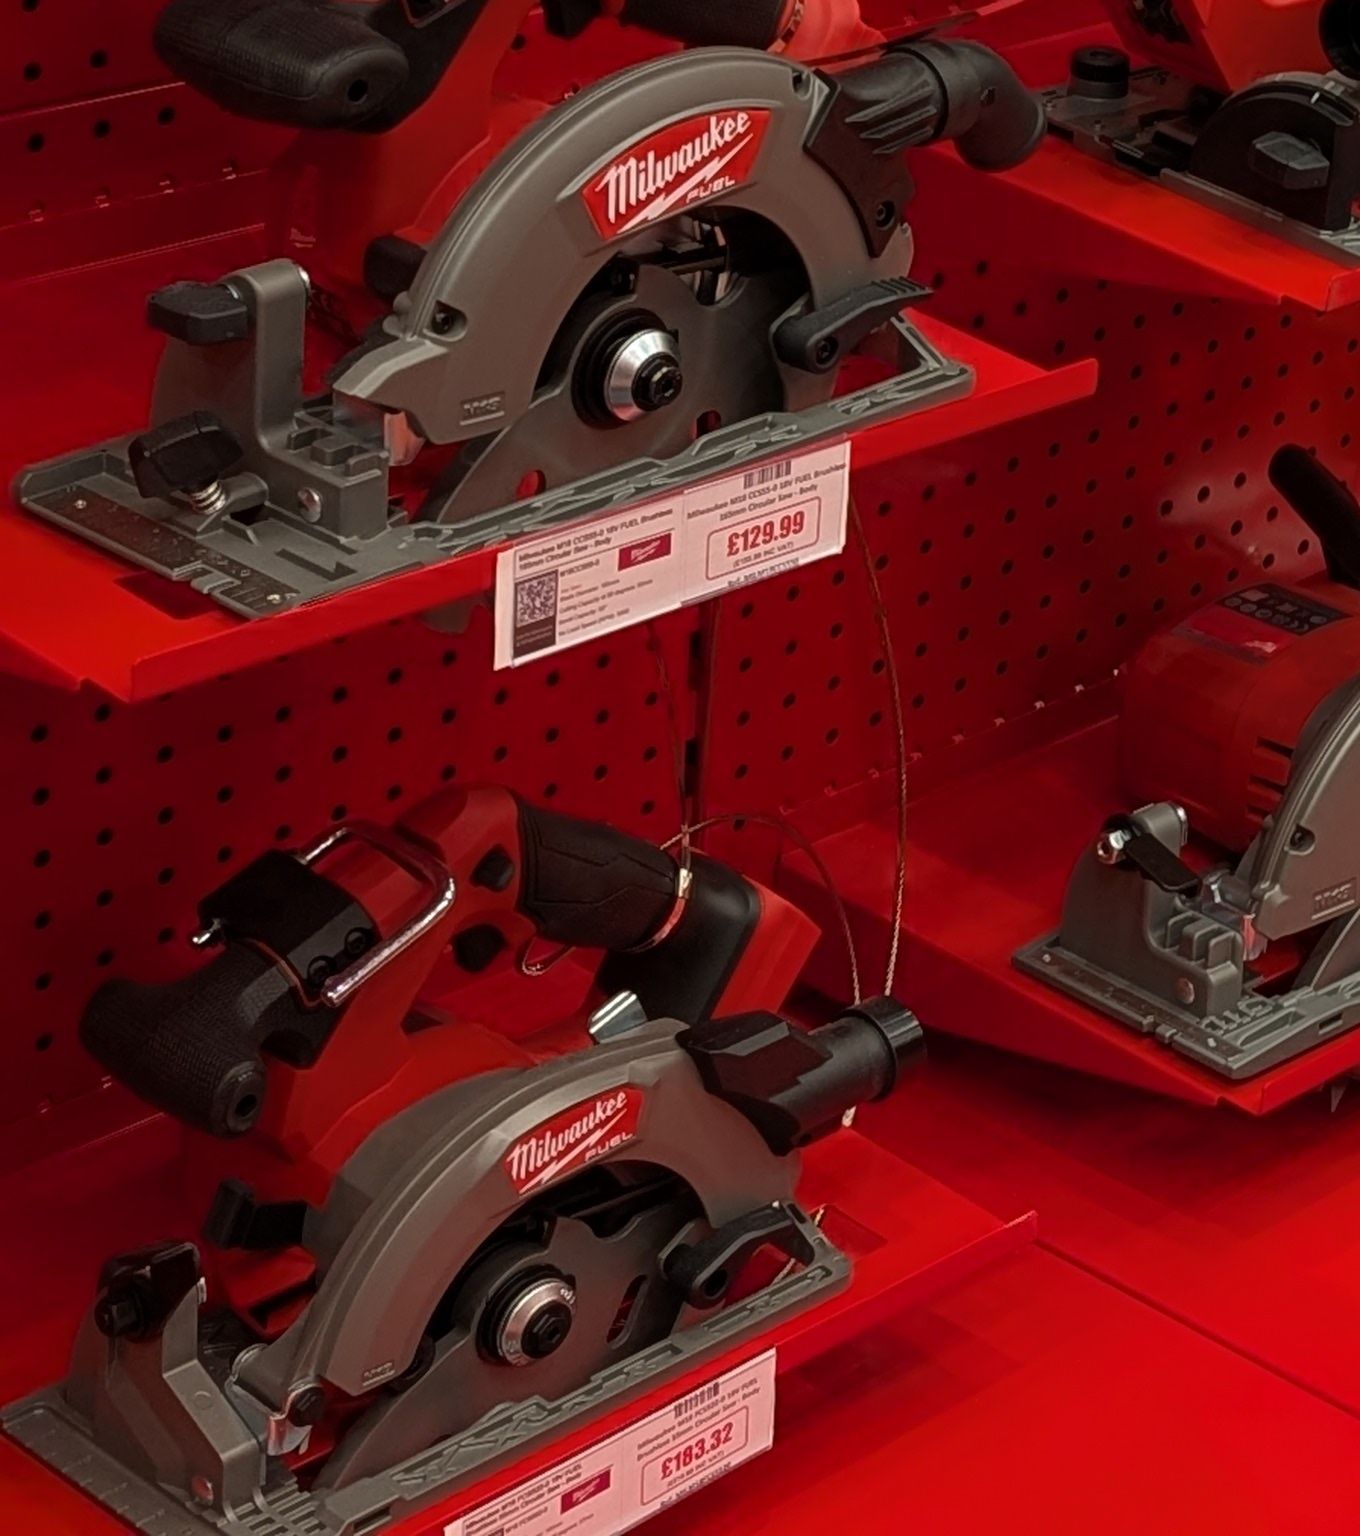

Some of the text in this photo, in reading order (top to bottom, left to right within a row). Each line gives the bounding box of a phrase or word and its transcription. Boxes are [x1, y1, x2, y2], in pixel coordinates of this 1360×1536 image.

[595, 111, 751, 224] Milwaukee
[686, 175, 735, 203] FUEL
[800, 484, 818, 496] Body
[687, 502, 728, 520] Milwaukee
[727, 511, 805, 557] £129.99
[507, 1091, 627, 1180] Milwaukee
[585, 1131, 636, 1163] FUEL
[661, 1422, 733, 1480] £183.32
